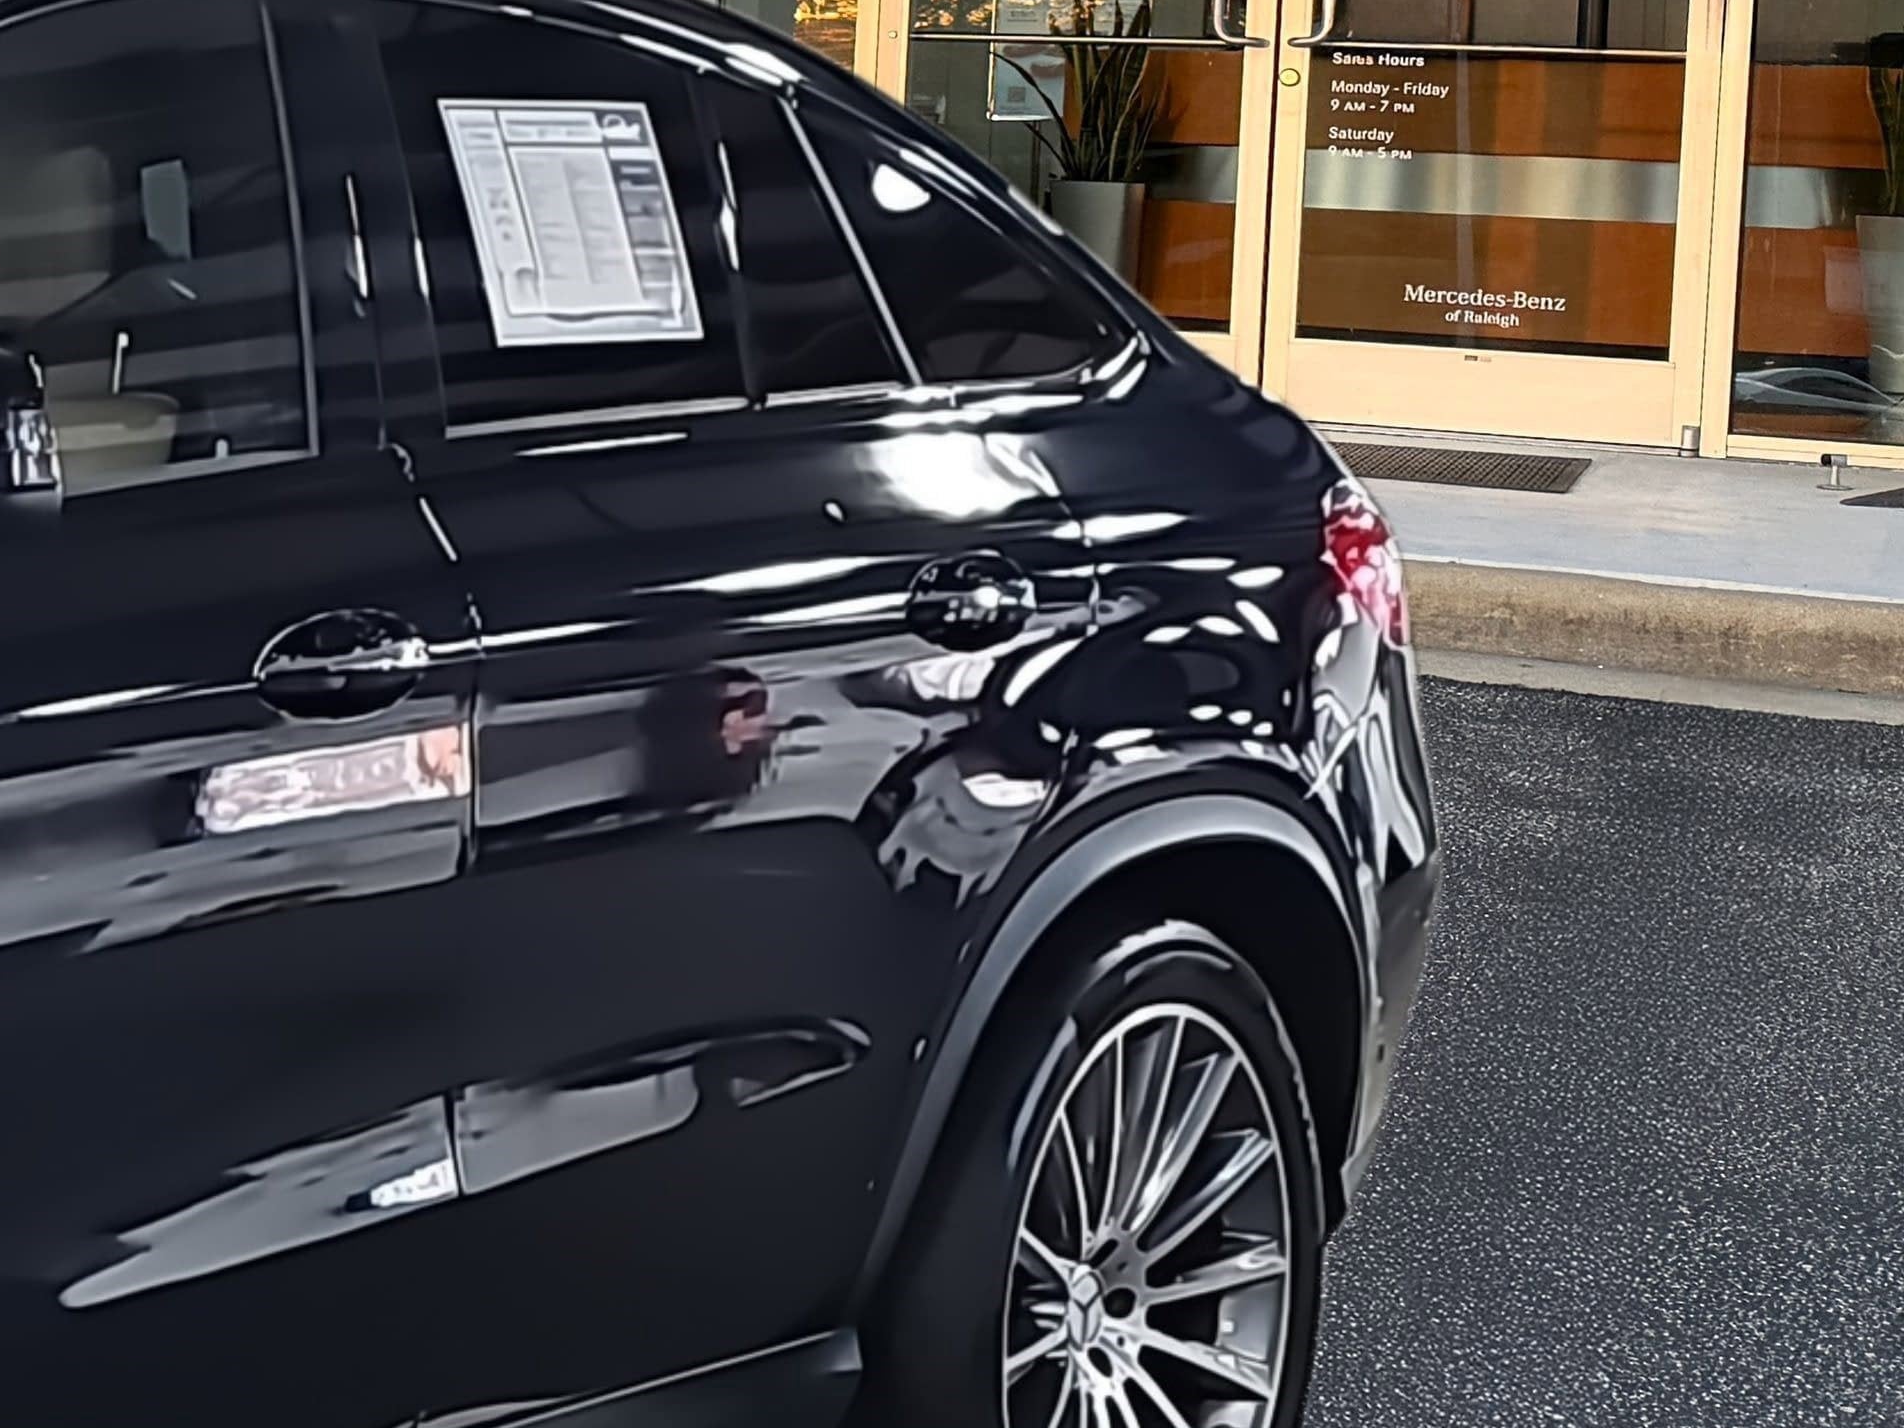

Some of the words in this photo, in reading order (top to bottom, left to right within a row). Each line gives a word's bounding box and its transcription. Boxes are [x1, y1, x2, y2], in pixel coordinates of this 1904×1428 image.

[1378, 53, 1425, 67] Hours
[1331, 79, 1390, 97] Monday
[1403, 81, 1449, 99] Friday
[1330, 98, 1340, 112] 9
[1344, 102, 1366, 112] AM
[1379, 100, 1389, 113] 7
[1393, 103, 1415, 114] PM
[1328, 126, 1394, 144] Saturday
[1391, 149, 1413, 160] PM
[1403, 283, 1566, 312] Mercedes-Benz
[1444, 309, 1461, 323] of
[1464, 310, 1520, 329] Raleigh
